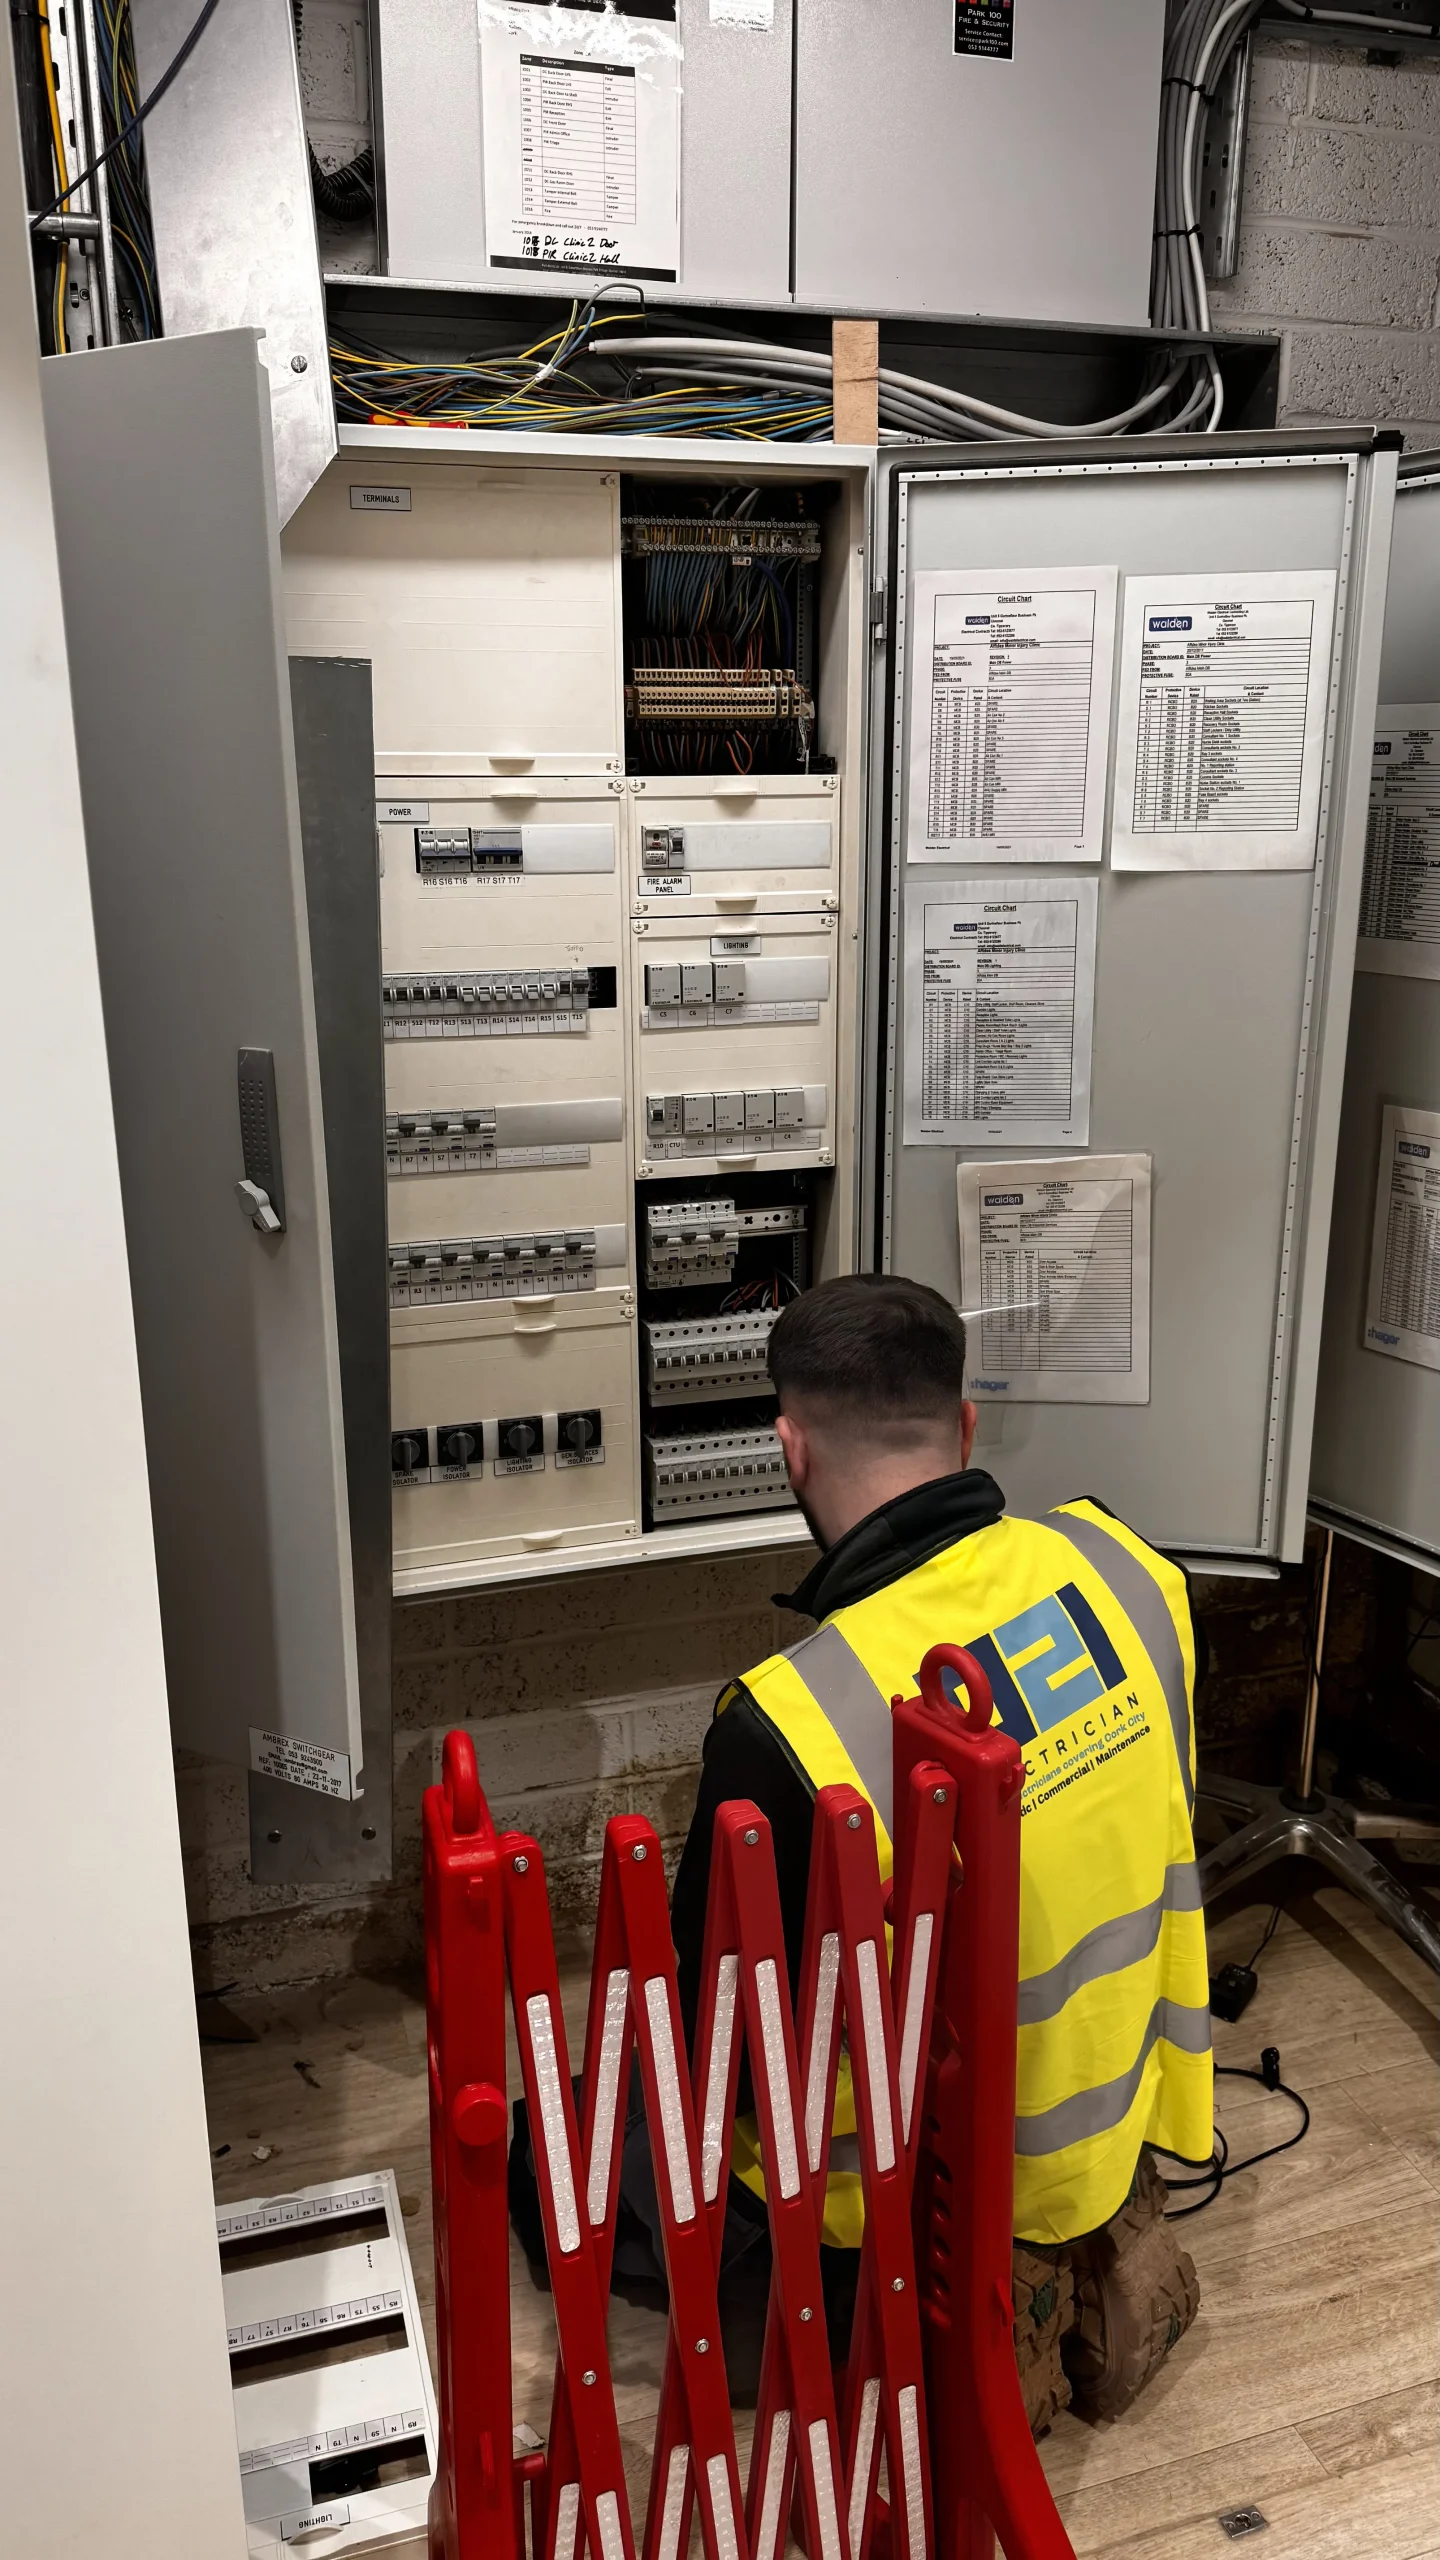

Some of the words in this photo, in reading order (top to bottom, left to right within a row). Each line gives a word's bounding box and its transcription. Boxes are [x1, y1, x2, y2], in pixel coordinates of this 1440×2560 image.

[989, 11, 1002, 19] 100
[982, 19, 1009, 28] SECURITY
[599, 239, 619, 248] Door
[543, 249, 557, 259] PIR
[600, 253, 620, 264] Hall
[363, 494, 399, 503] TERMINALS
[1152, 618, 1189, 629] walden
[389, 808, 412, 816] POWER
[987, 1195, 1020, 1204] walden
[974, 1378, 1009, 1392] hager
[568, 1457, 593, 1465] ISOLATOR
[507, 1464, 533, 1473] ISOLATOR
[443, 1471, 470, 1479] ISOLATOR
[393, 1477, 419, 1485] SOLATOR
[1063, 1739, 1104, 1770] covering
[1104, 1724, 1127, 1742] Cork
[1128, 1712, 1146, 1727] City
[262, 1733, 289, 1747] AMBREX
[293, 1742, 335, 1762] SWITCHGEAR
[276, 1746, 285, 1755] TEL
[259, 1756, 270, 1765] REF:
[291, 1766, 305, 1776] DATE
[1037, 1762, 1090, 1804] Commercial
[1096, 1725, 1150, 1766] Maintenance
[275, 1769, 291, 1780] VOLTS
[303, 1778, 319, 1788] AMPS
[322, 1783, 328, 1792] 50
[299, 2514, 332, 2529] LIGHTING
